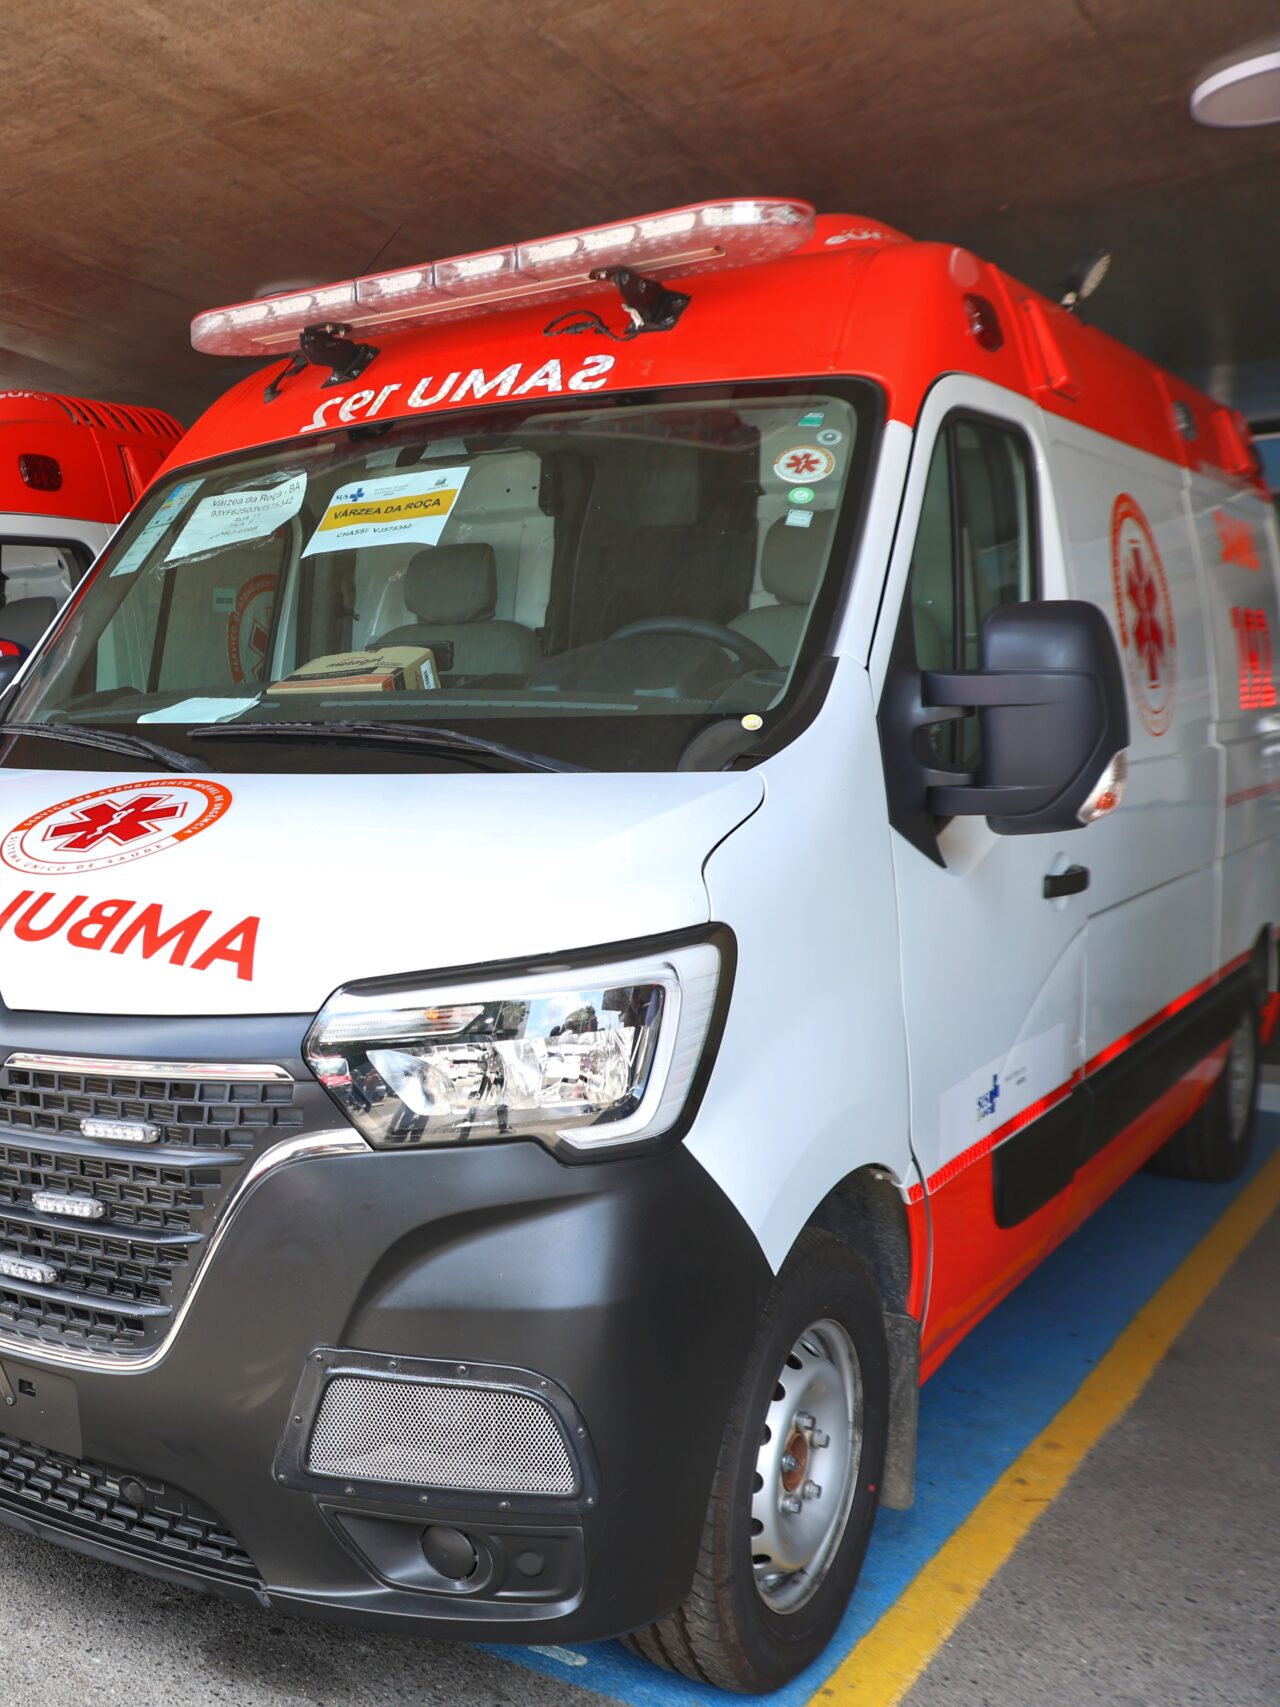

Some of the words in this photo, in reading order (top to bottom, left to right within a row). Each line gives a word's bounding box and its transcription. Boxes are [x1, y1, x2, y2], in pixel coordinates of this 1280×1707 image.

[213, 494, 243, 507] Várzea
[245, 495, 258, 505] da
[260, 491, 282, 503] Roça
[289, 482, 301, 495] BA
[333, 507, 381, 519] VÁRZEA
[384, 505, 402, 514] DA
[404, 498, 441, 511] ROÇA
[75, 794, 92, 802] DE
[98, 780, 193, 796] ATENDIMENTO
[76, 862, 95, 870] DE
